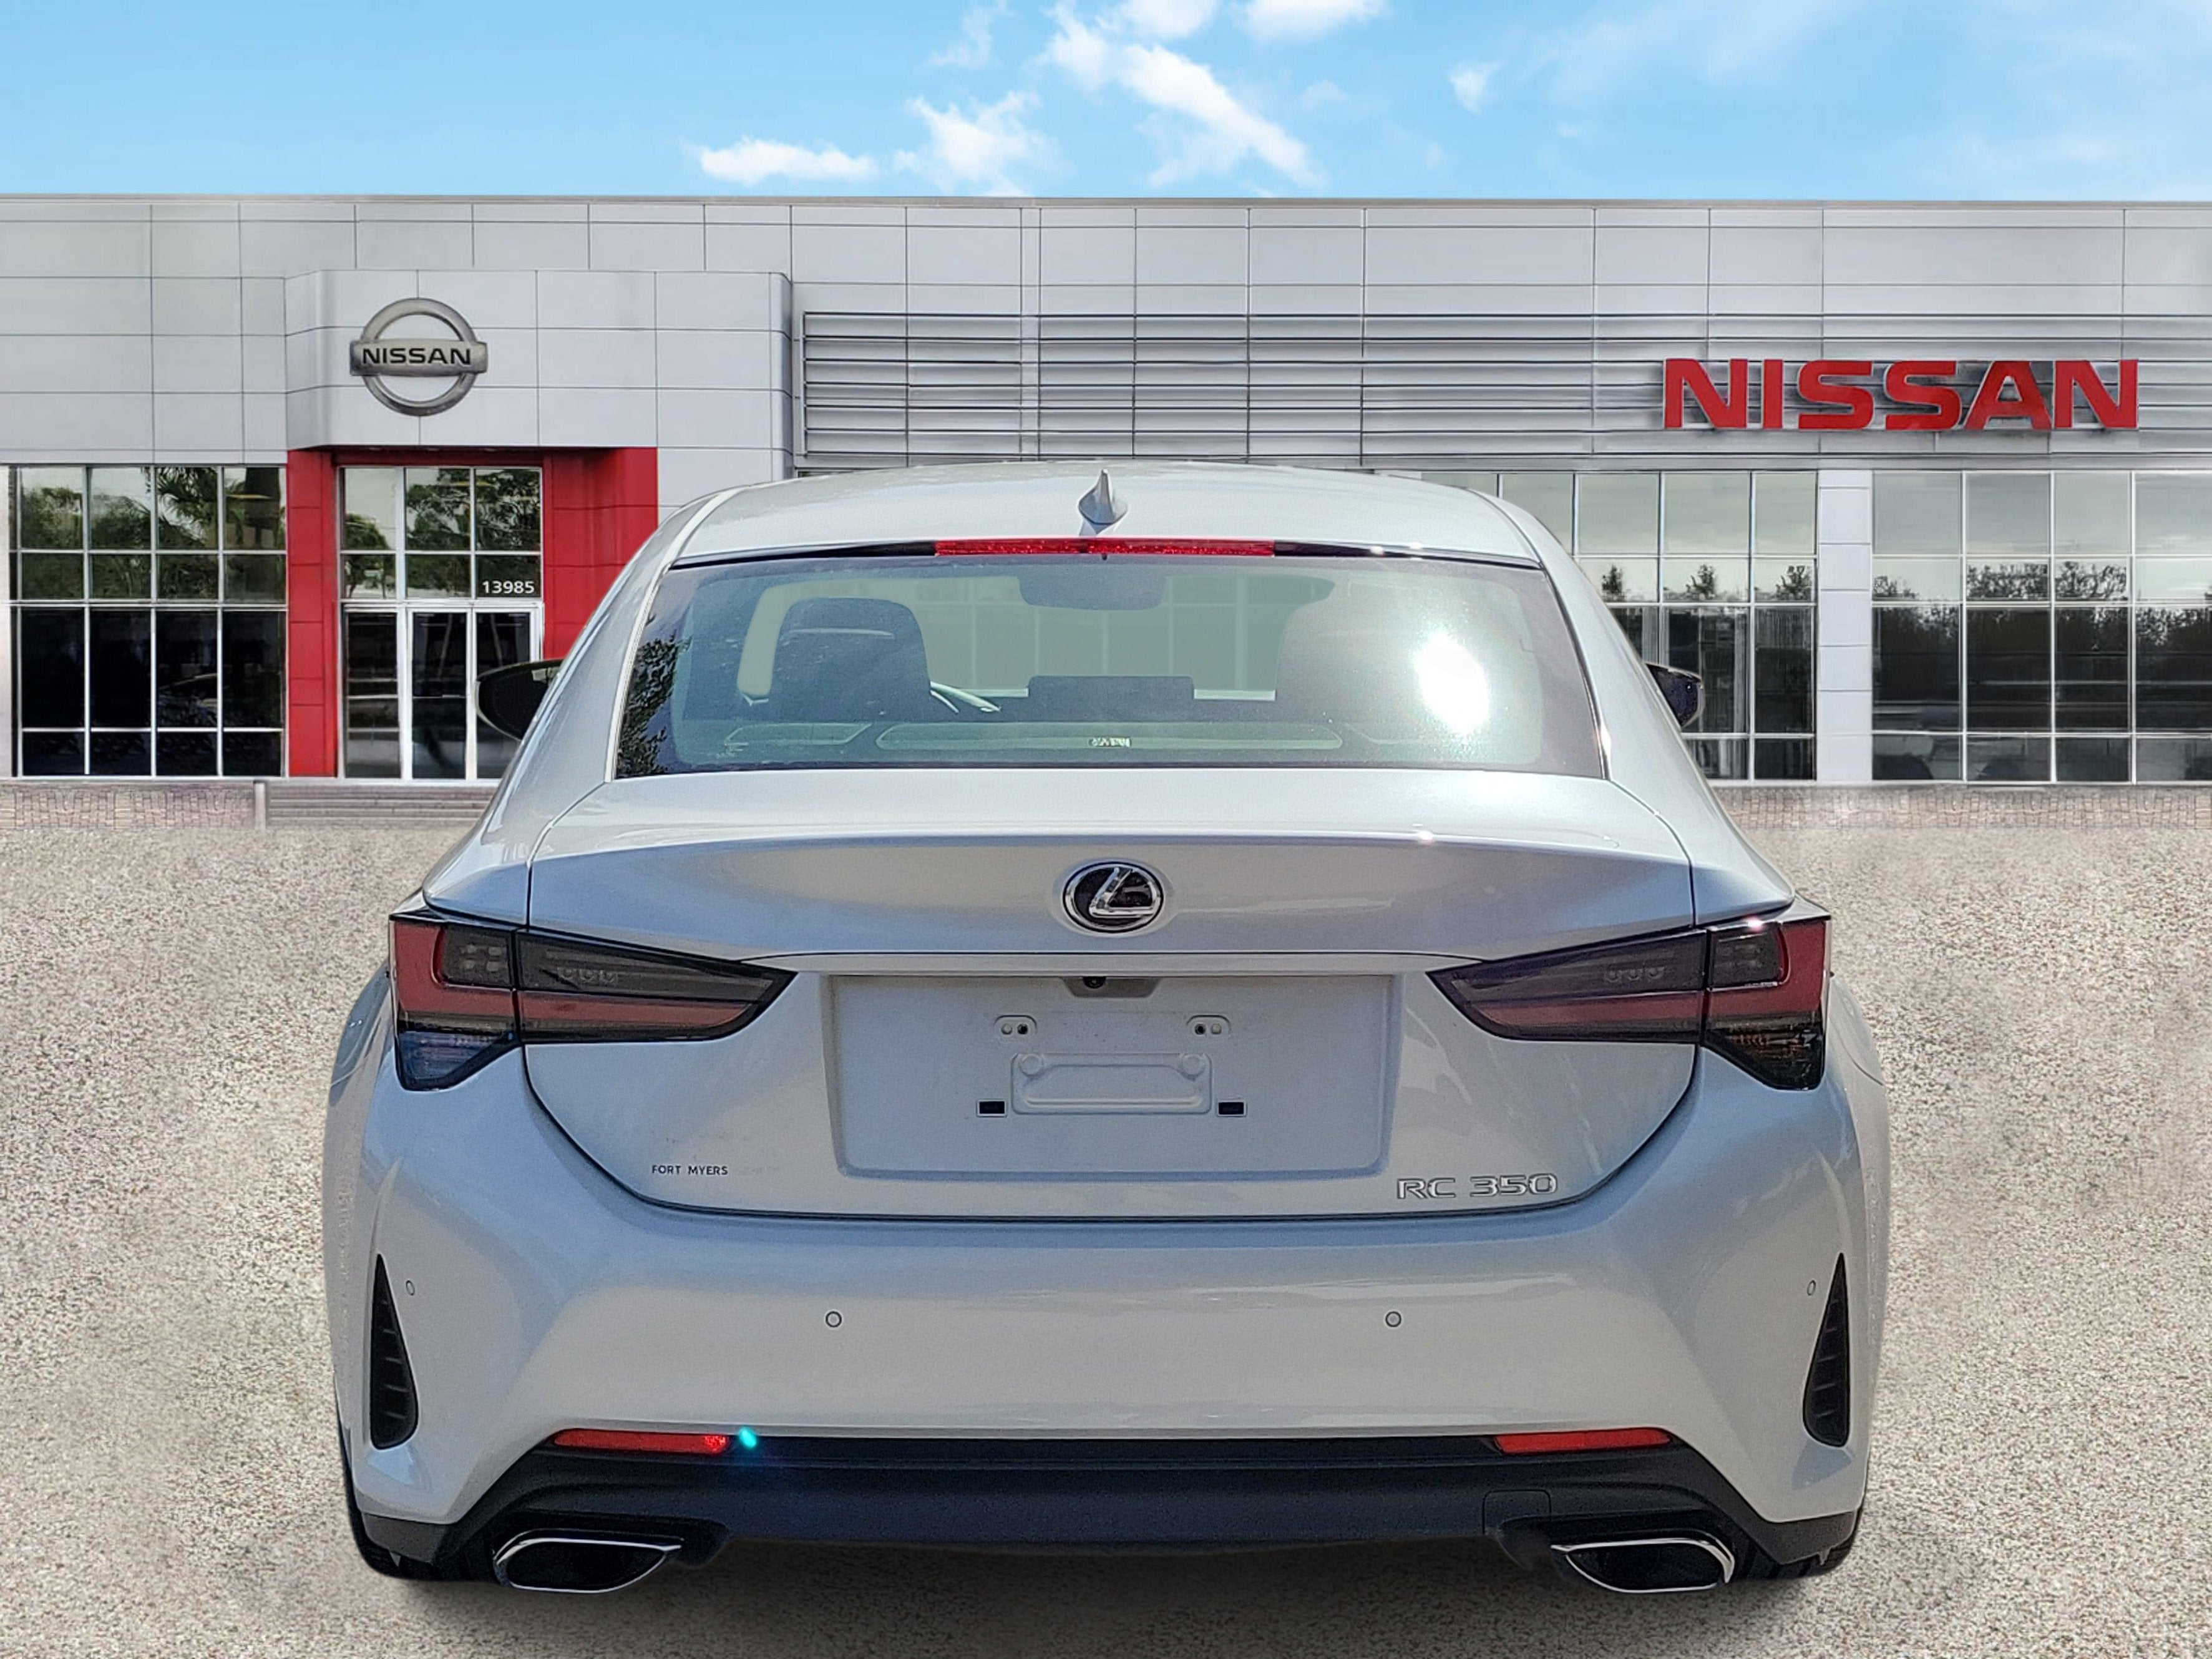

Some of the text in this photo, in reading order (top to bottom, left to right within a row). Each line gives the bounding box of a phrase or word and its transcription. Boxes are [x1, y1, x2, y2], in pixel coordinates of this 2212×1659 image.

[363, 348, 471, 365] NISSAN
[1664, 358, 2138, 429] NISSAN
[482, 580, 535, 594] 13985
[651, 1165, 728, 1175] FORT MYERS
[1396, 1172, 1558, 1199] RC 350
